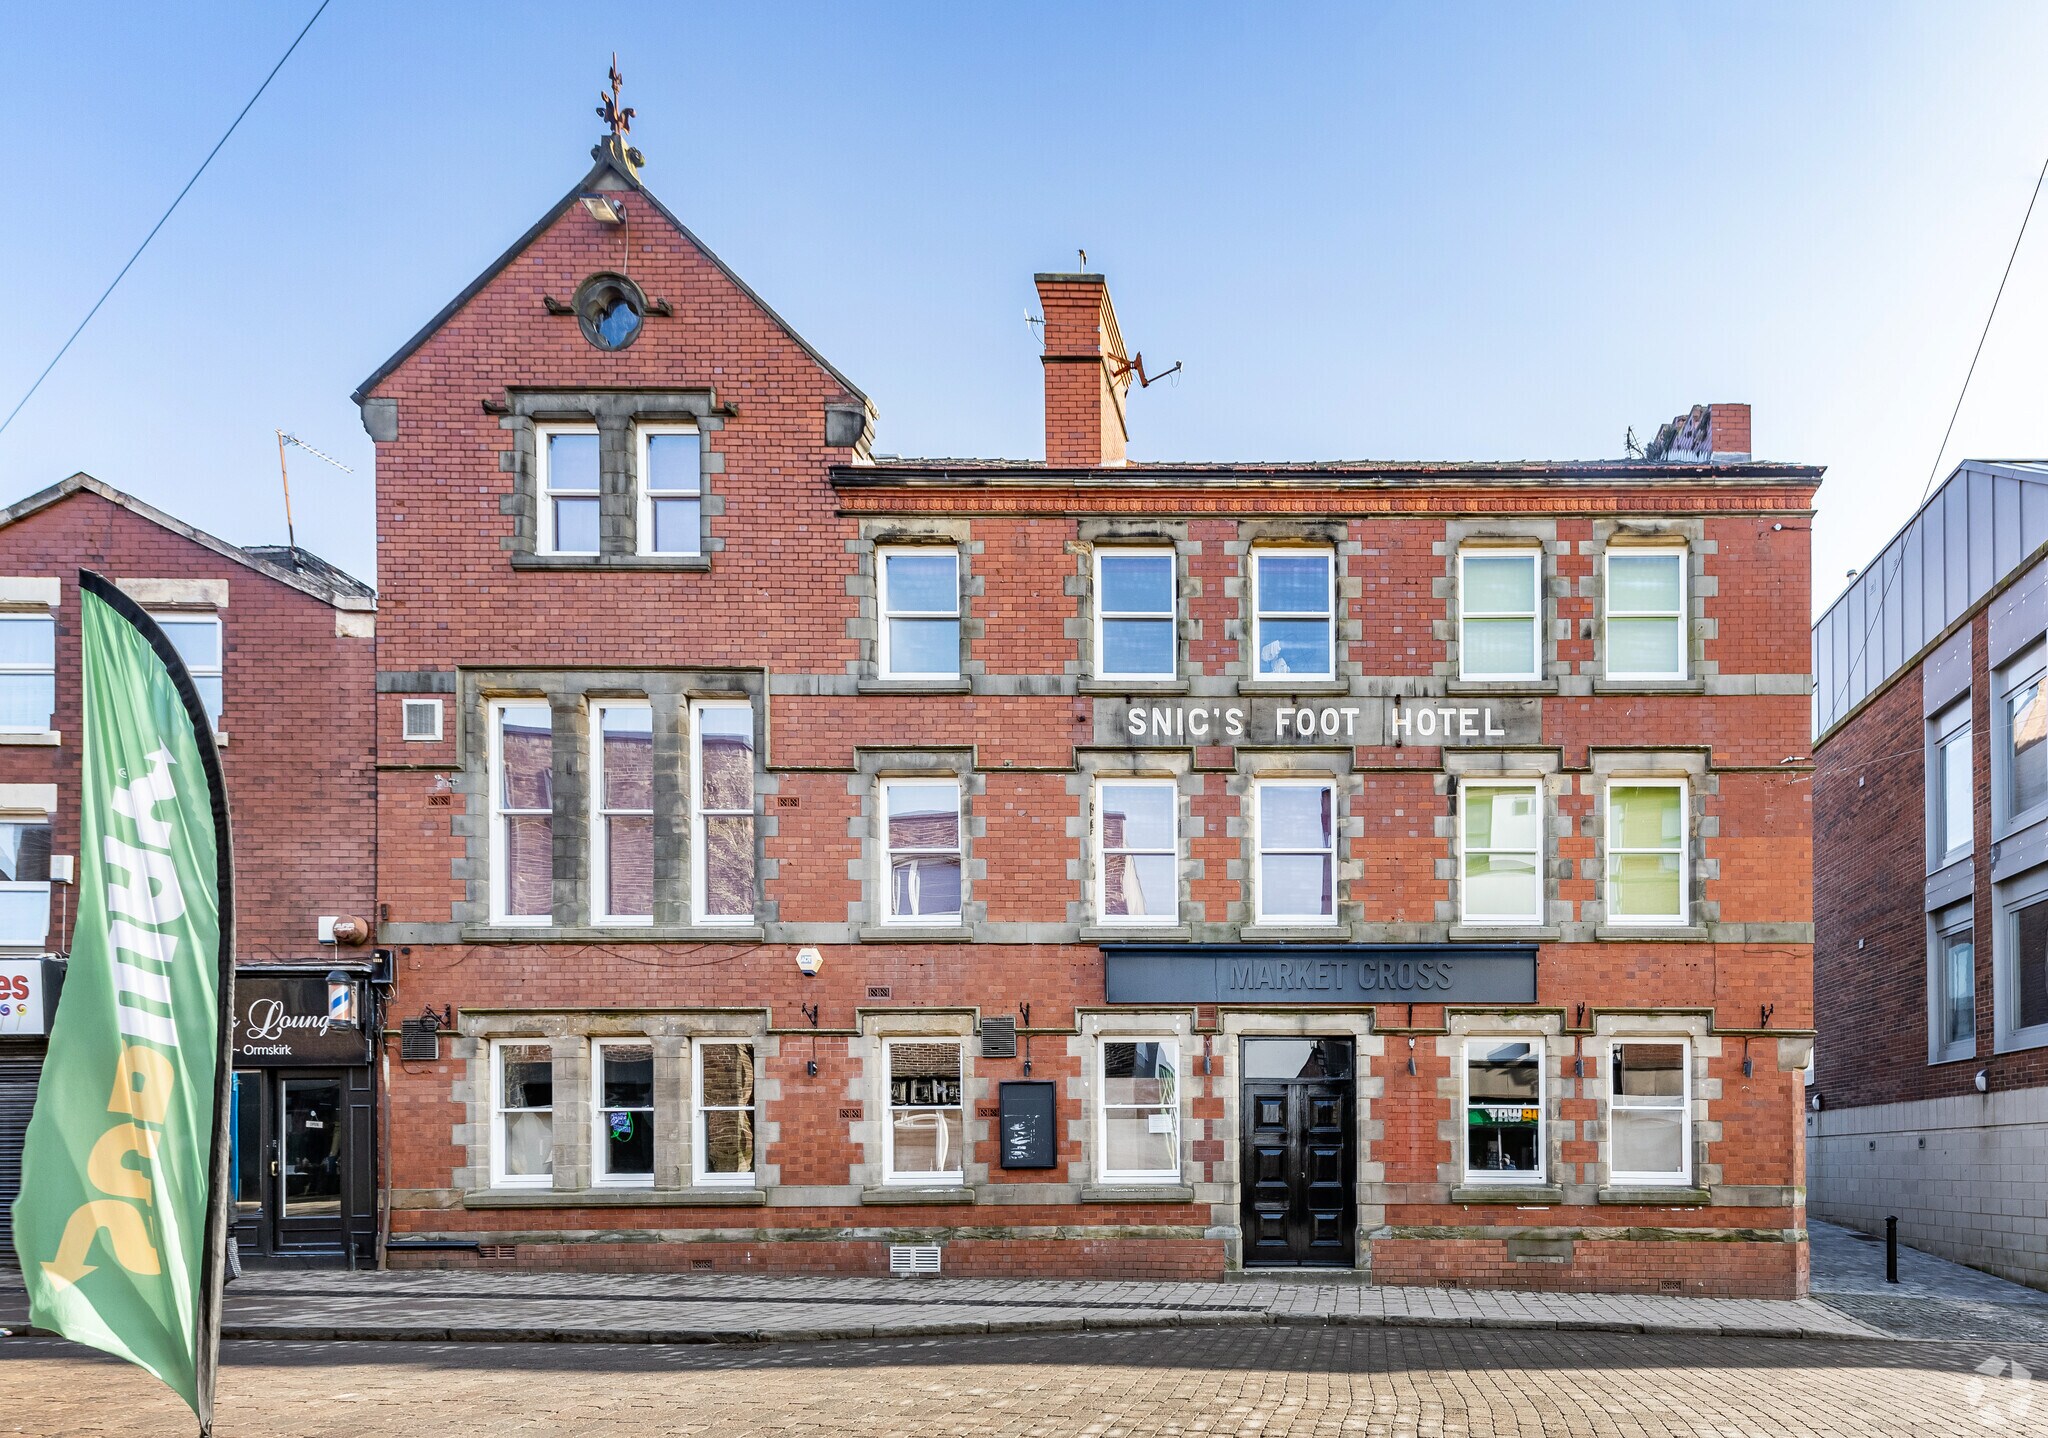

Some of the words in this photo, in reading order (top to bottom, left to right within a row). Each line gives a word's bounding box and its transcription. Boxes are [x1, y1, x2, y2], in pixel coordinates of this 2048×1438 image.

[1128, 707, 1244, 736] SNIC'S
[1276, 707, 1360, 736] FOOT
[1392, 707, 1505, 736] HOTEL
[1229, 959, 1348, 990] MARKET
[1358, 959, 1454, 991] CROSS
[246, 998, 330, 1040] Loung
[243, 1044, 292, 1056] Ormskirk
